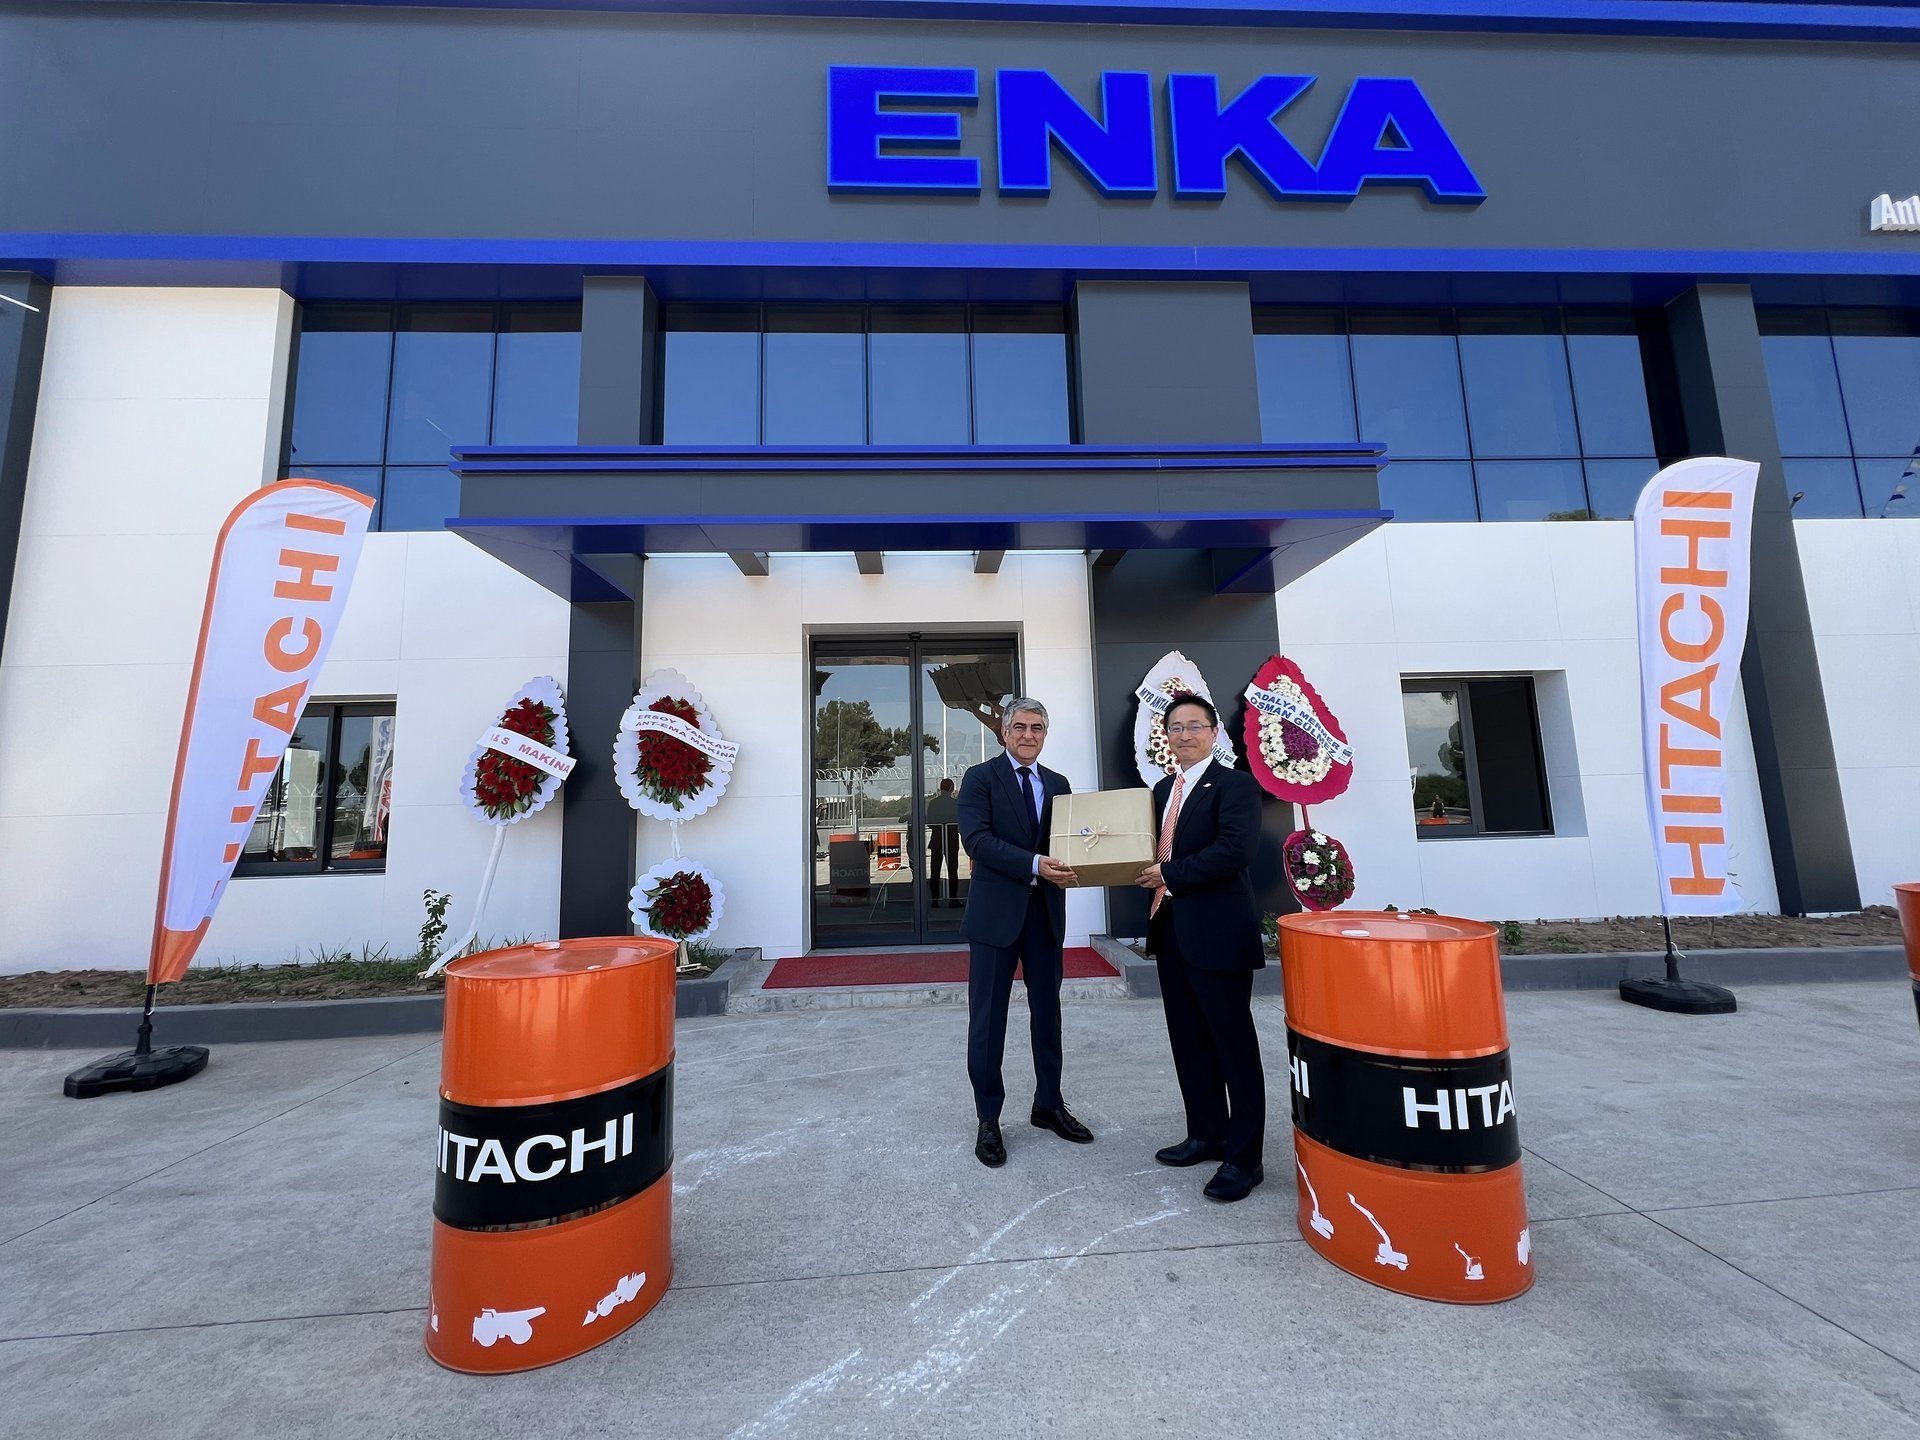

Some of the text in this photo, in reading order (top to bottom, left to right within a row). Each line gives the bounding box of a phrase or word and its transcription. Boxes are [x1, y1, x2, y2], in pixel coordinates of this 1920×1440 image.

[827, 65, 1487, 203] ENKA
[637, 714, 677, 724] ERSOY
[1254, 691, 1340, 750] ADALYA MERMER
[1659, 490, 1733, 896] HITACHI
[1250, 696, 1337, 757] OSMAN GÜLMEZ
[1402, 1079, 1517, 1131] HITA
